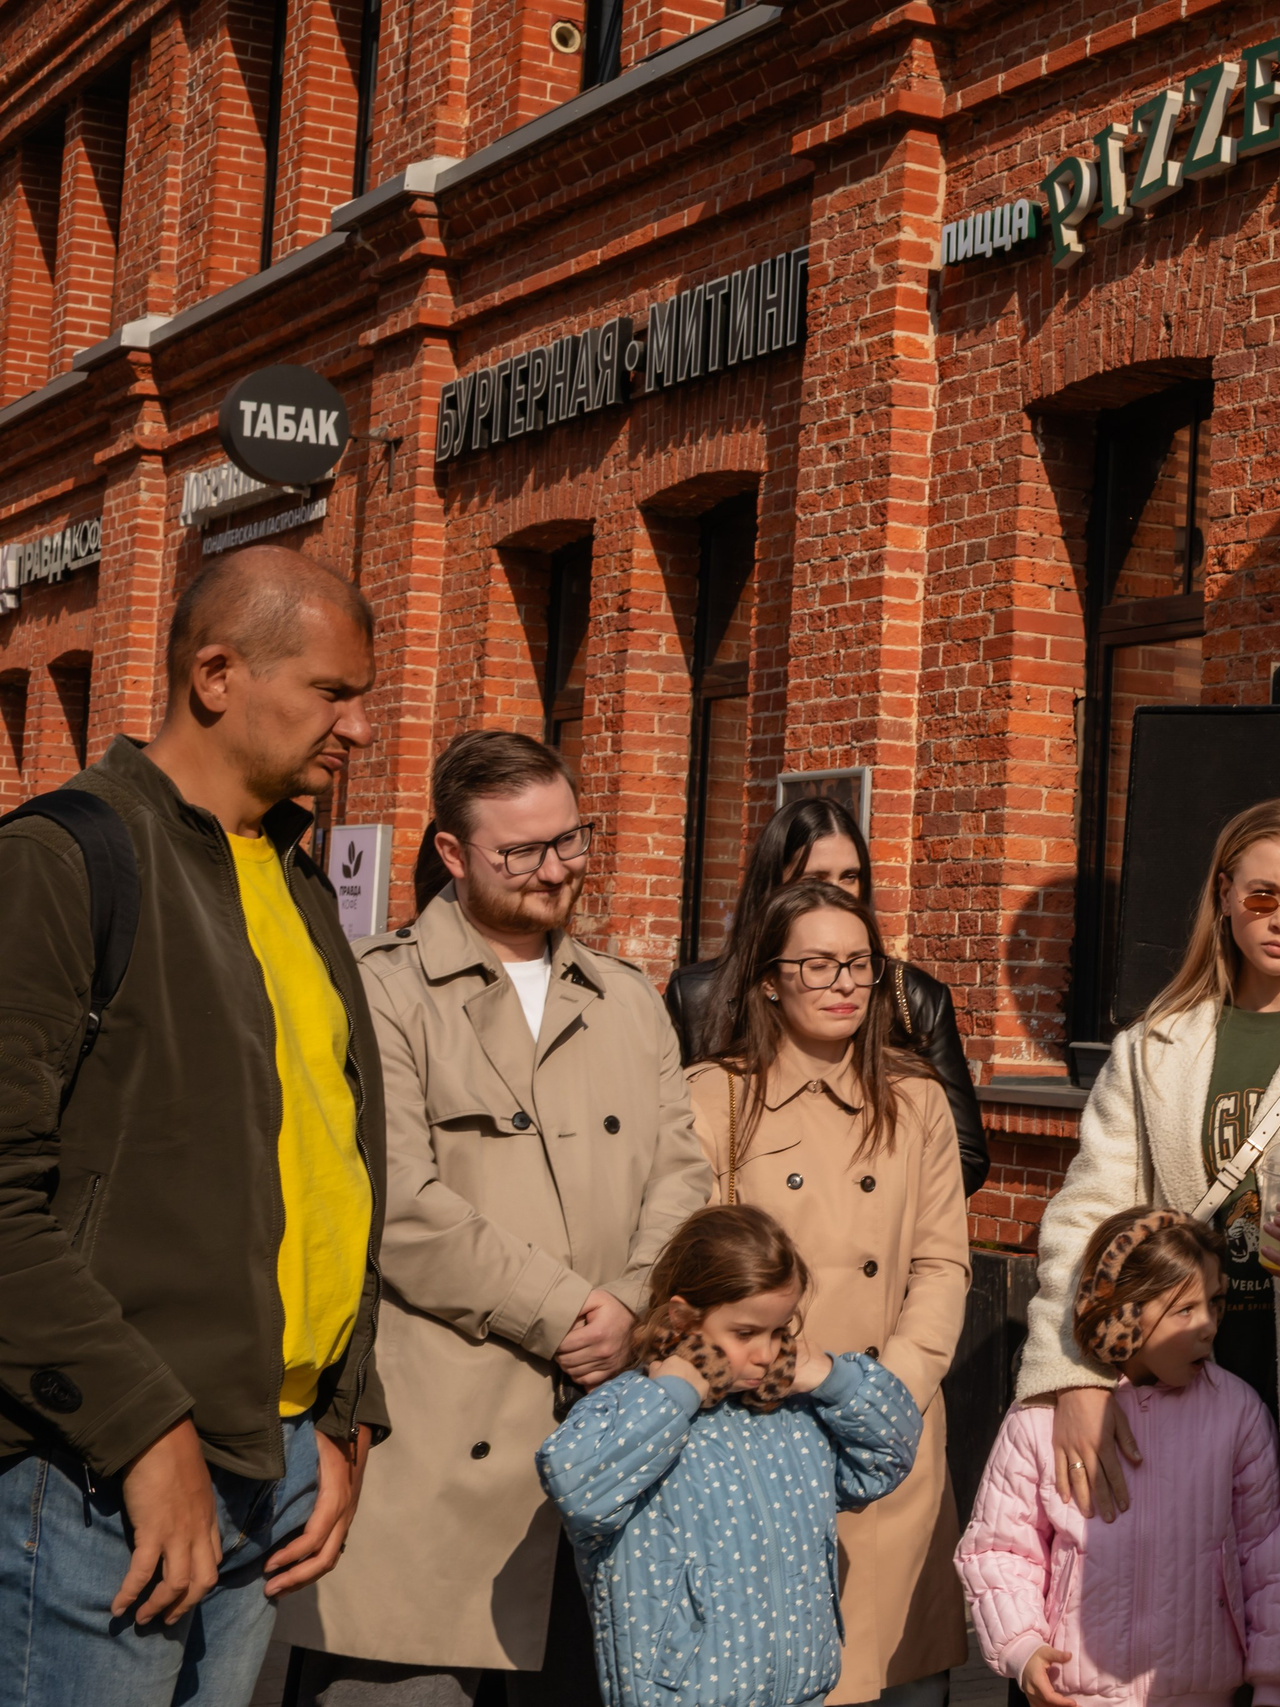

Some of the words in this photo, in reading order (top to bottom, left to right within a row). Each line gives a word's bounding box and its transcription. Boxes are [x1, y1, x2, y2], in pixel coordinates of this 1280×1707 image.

[941, 198, 1032, 265] ПИЦЦА
[436, 316, 622, 463] БУРГЕРНАЯ
[645, 244, 809, 393] МИТИНГ
[240, 401, 339, 446] ТАБАК
[16, 527, 72, 585] ПРАВДА
[1227, 1277, 1272, 1292] VERLA
